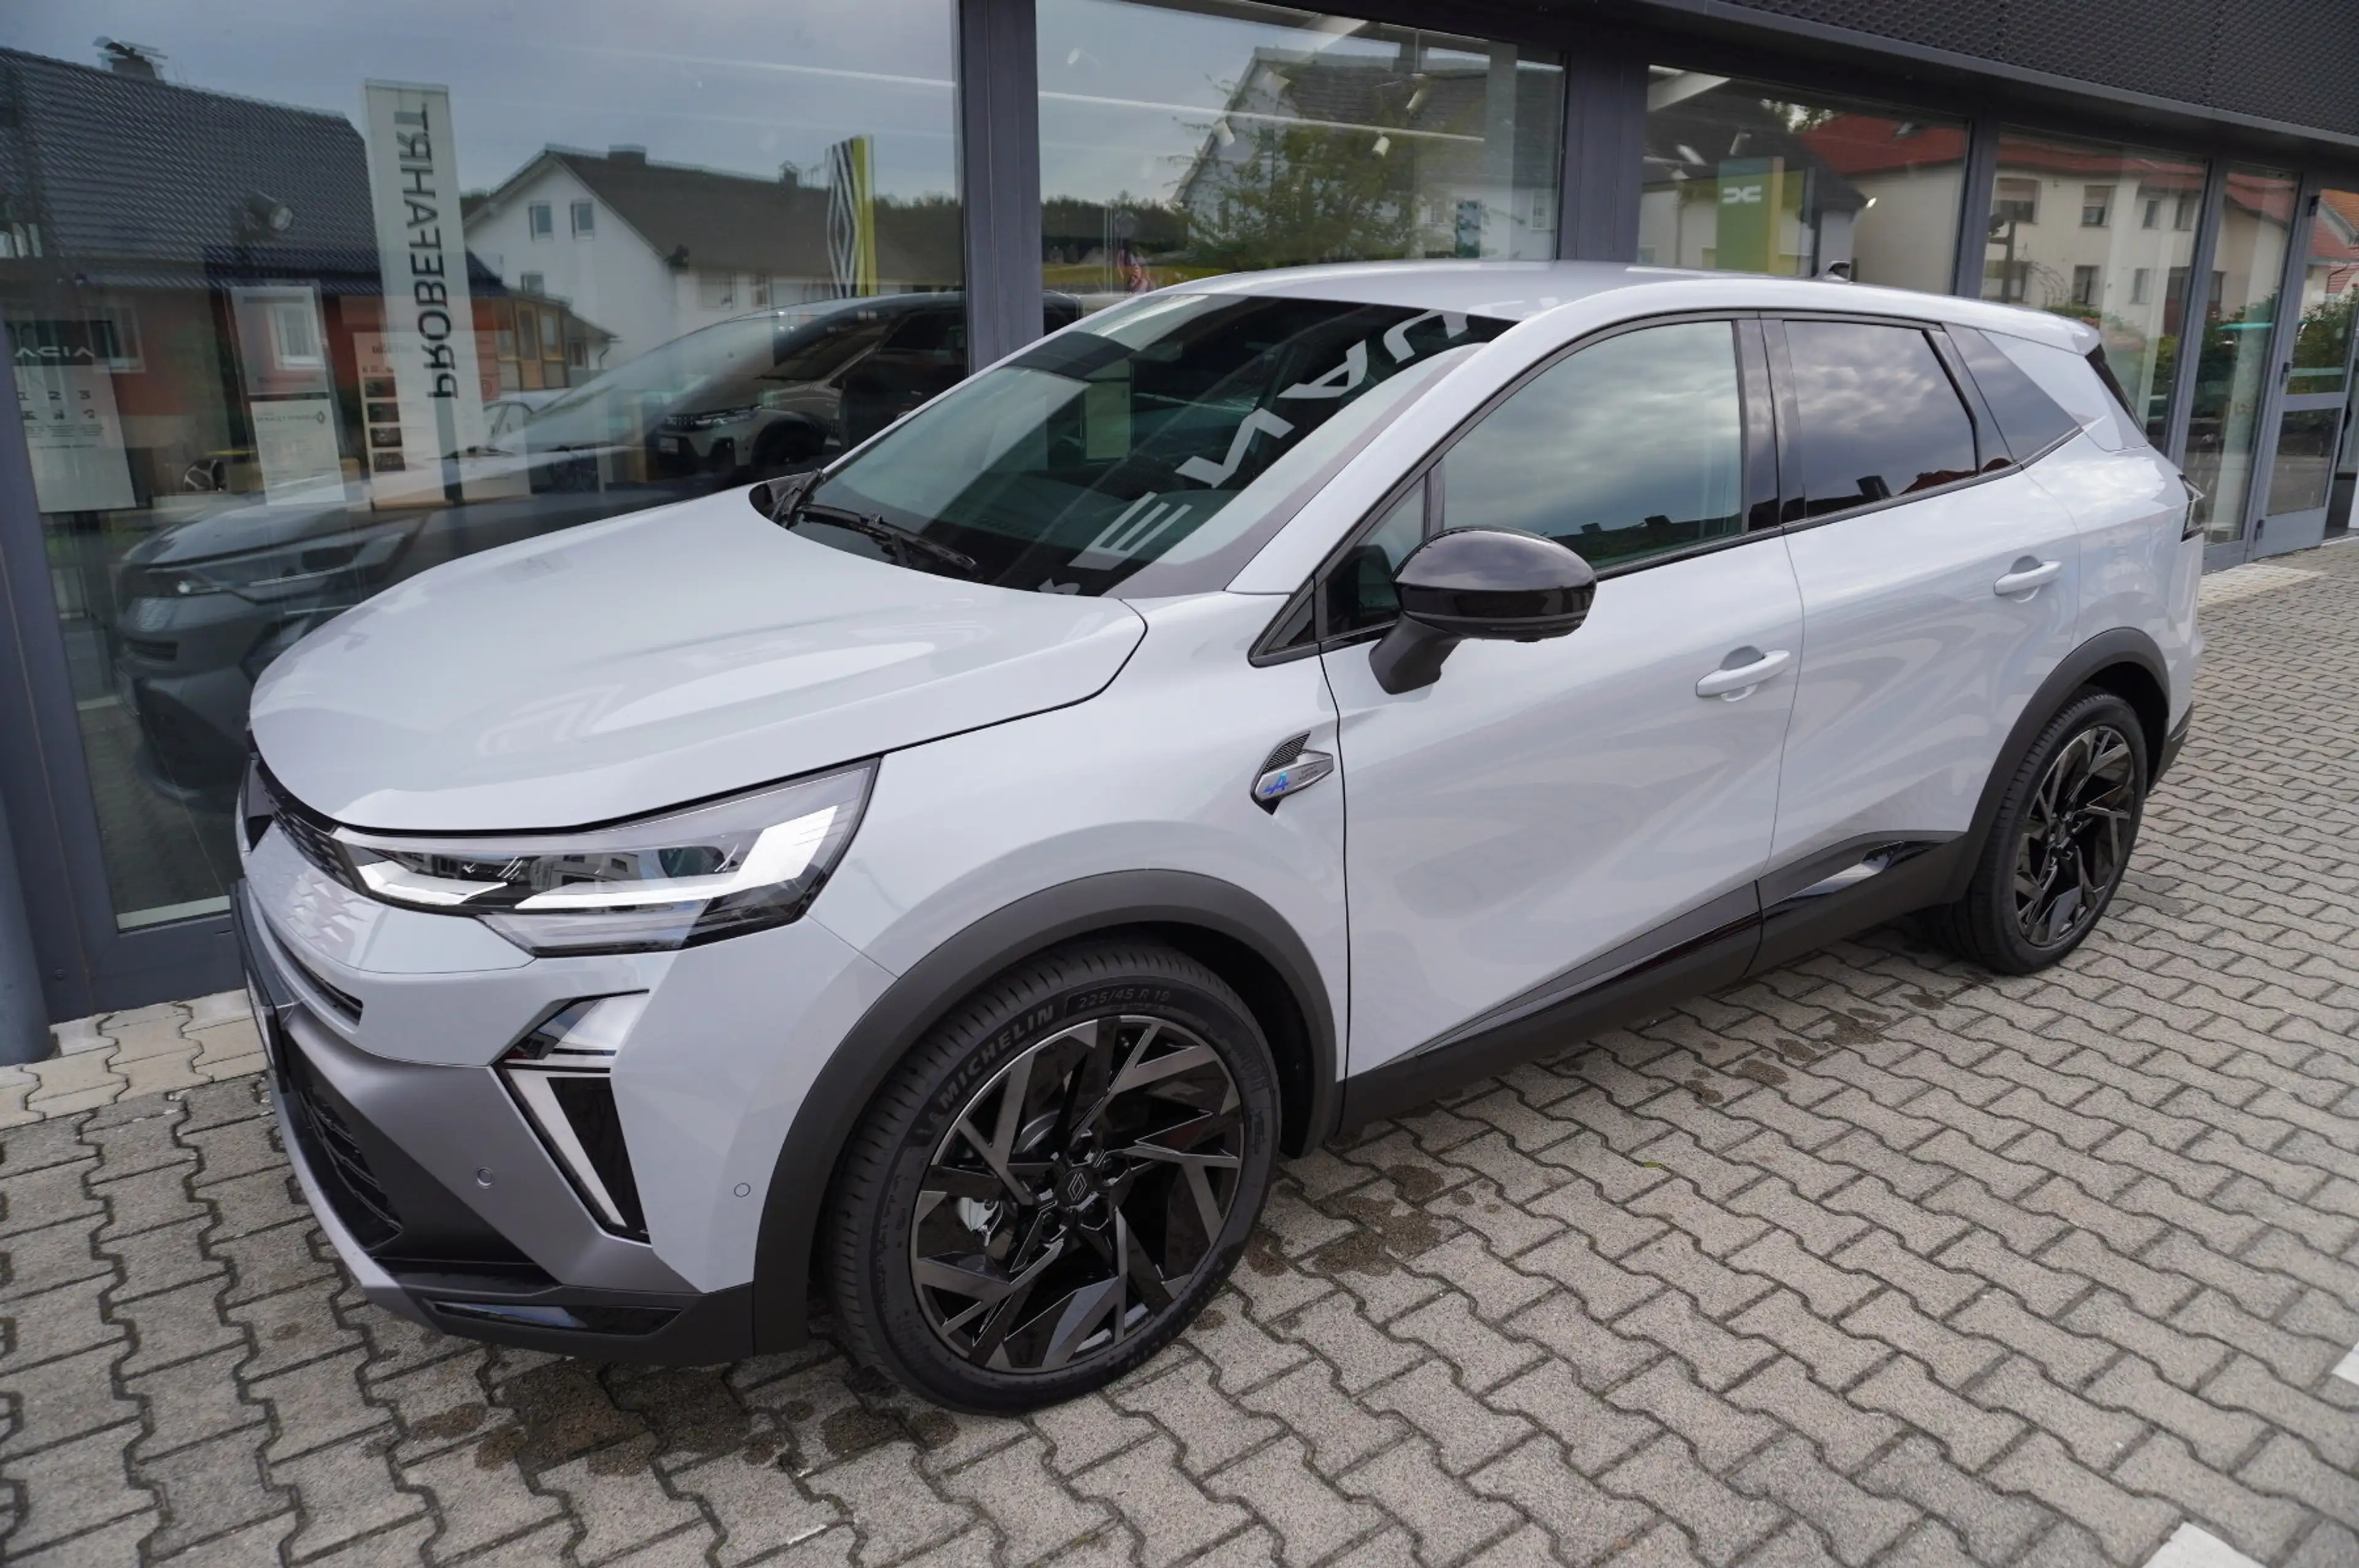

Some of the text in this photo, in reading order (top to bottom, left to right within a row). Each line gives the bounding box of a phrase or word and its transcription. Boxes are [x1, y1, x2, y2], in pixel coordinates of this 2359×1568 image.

[14, 346, 95, 357] ACIA
[1078, 988, 1135, 1008] 225/45
[1139, 988, 1150, 999] R
[938, 1005, 1054, 1110] MICHELIN
